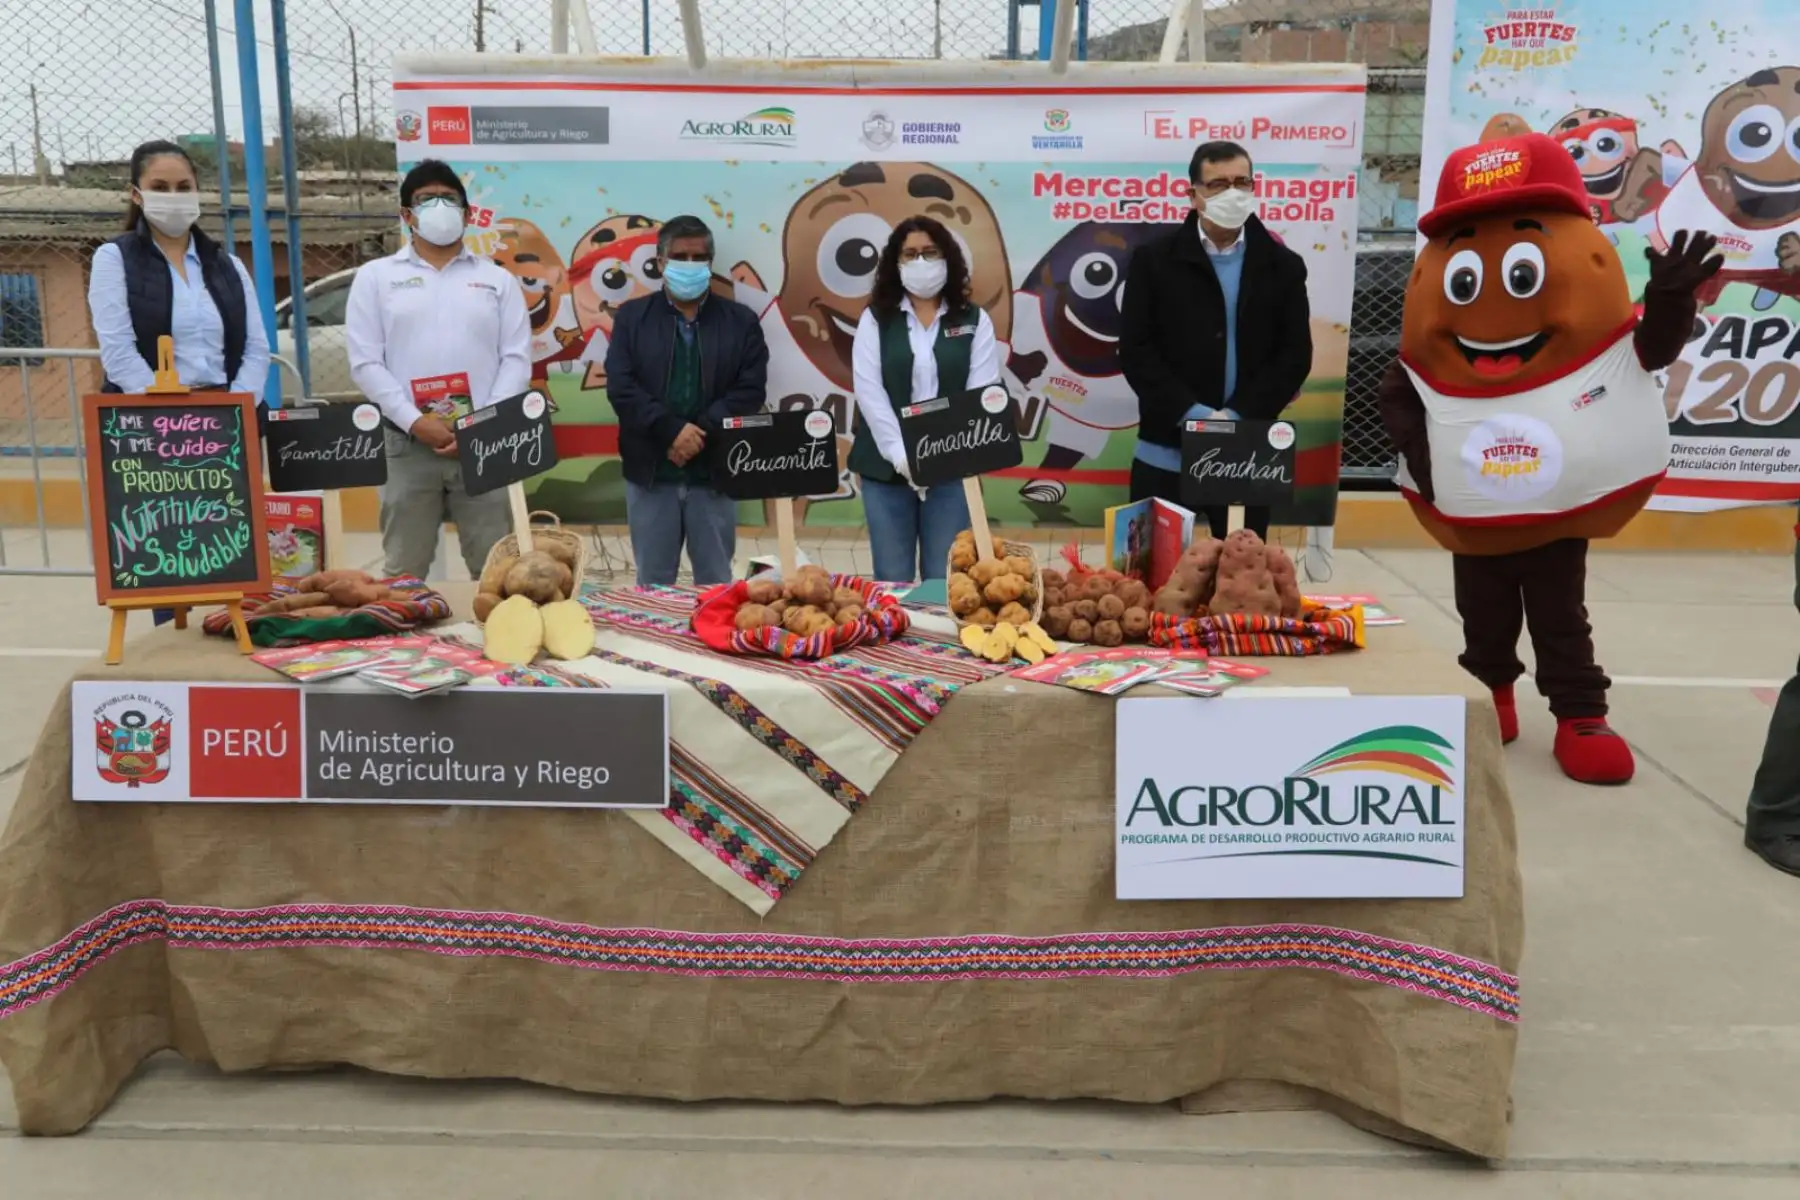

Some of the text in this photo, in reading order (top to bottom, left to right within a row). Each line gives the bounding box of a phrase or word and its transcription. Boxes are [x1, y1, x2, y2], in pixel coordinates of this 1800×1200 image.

[1507, 9, 1554, 20] PARA ESTAR
[1484, 21, 1576, 44] FUERTES
[1479, 44, 1578, 72] papear
[432, 118, 466, 131] PERÚ
[476, 120, 528, 129] Ministerio
[902, 122, 961, 133] GOBIERNO
[476, 130, 588, 141] de Agricultura y Riego
[902, 134, 960, 145] REGIONAL
[1465, 161, 1522, 190] papear
[1252, 172, 1356, 203] inagri
[1715, 236, 1754, 252] UERTES
[119, 416, 144, 429] ME
[110, 436, 228, 457] Y ME cuido
[1482, 444, 1538, 460] FUERTES
[1671, 443, 1791, 458] Dirección General de
[727, 438, 831, 477] Peruanita
[1667, 458, 1736, 471] Articulación
[112, 459, 142, 473] CON
[124, 468, 233, 493] PRODUCTOS
[133, 521, 249, 577] Saludables
[203, 722, 288, 758] PERÚ
[319, 730, 455, 754] Ministerio
[319, 758, 610, 789] de Agricultura y Riego
[1121, 832, 1456, 845] PROGRAMA DE DESARROLLO PRODUCTIVO AGRARIO RURAL
